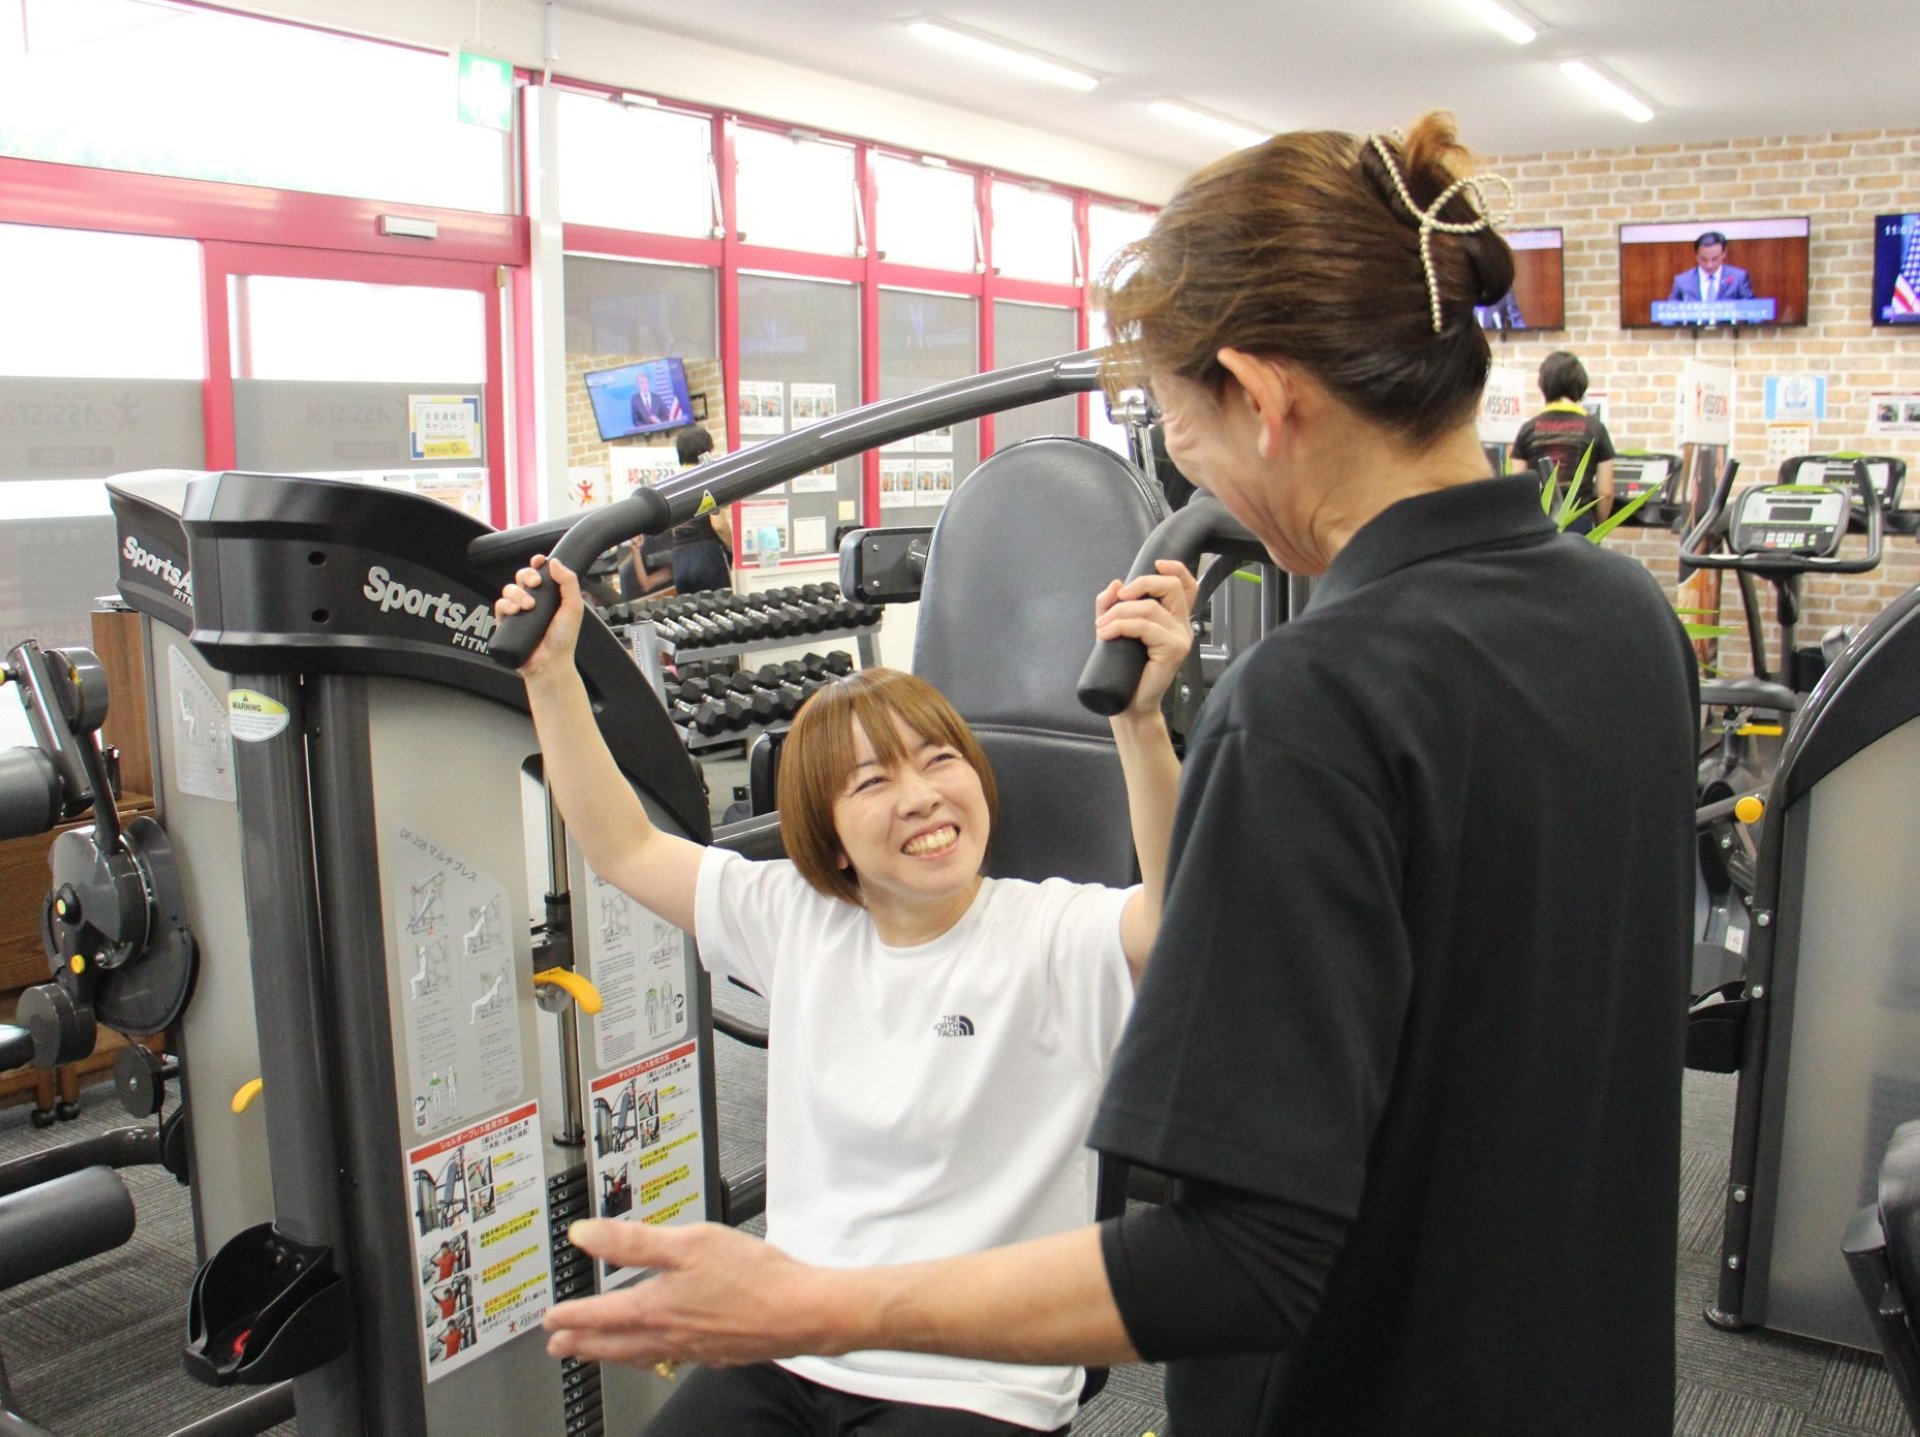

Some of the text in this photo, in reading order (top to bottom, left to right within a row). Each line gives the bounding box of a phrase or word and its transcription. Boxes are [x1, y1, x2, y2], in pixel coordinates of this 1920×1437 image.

[363, 566, 497, 639] SportsAr
[452, 632, 489, 654] FITN
[232, 702, 262, 712] WARNING
[430, 845, 477, 883] マルチプレス
